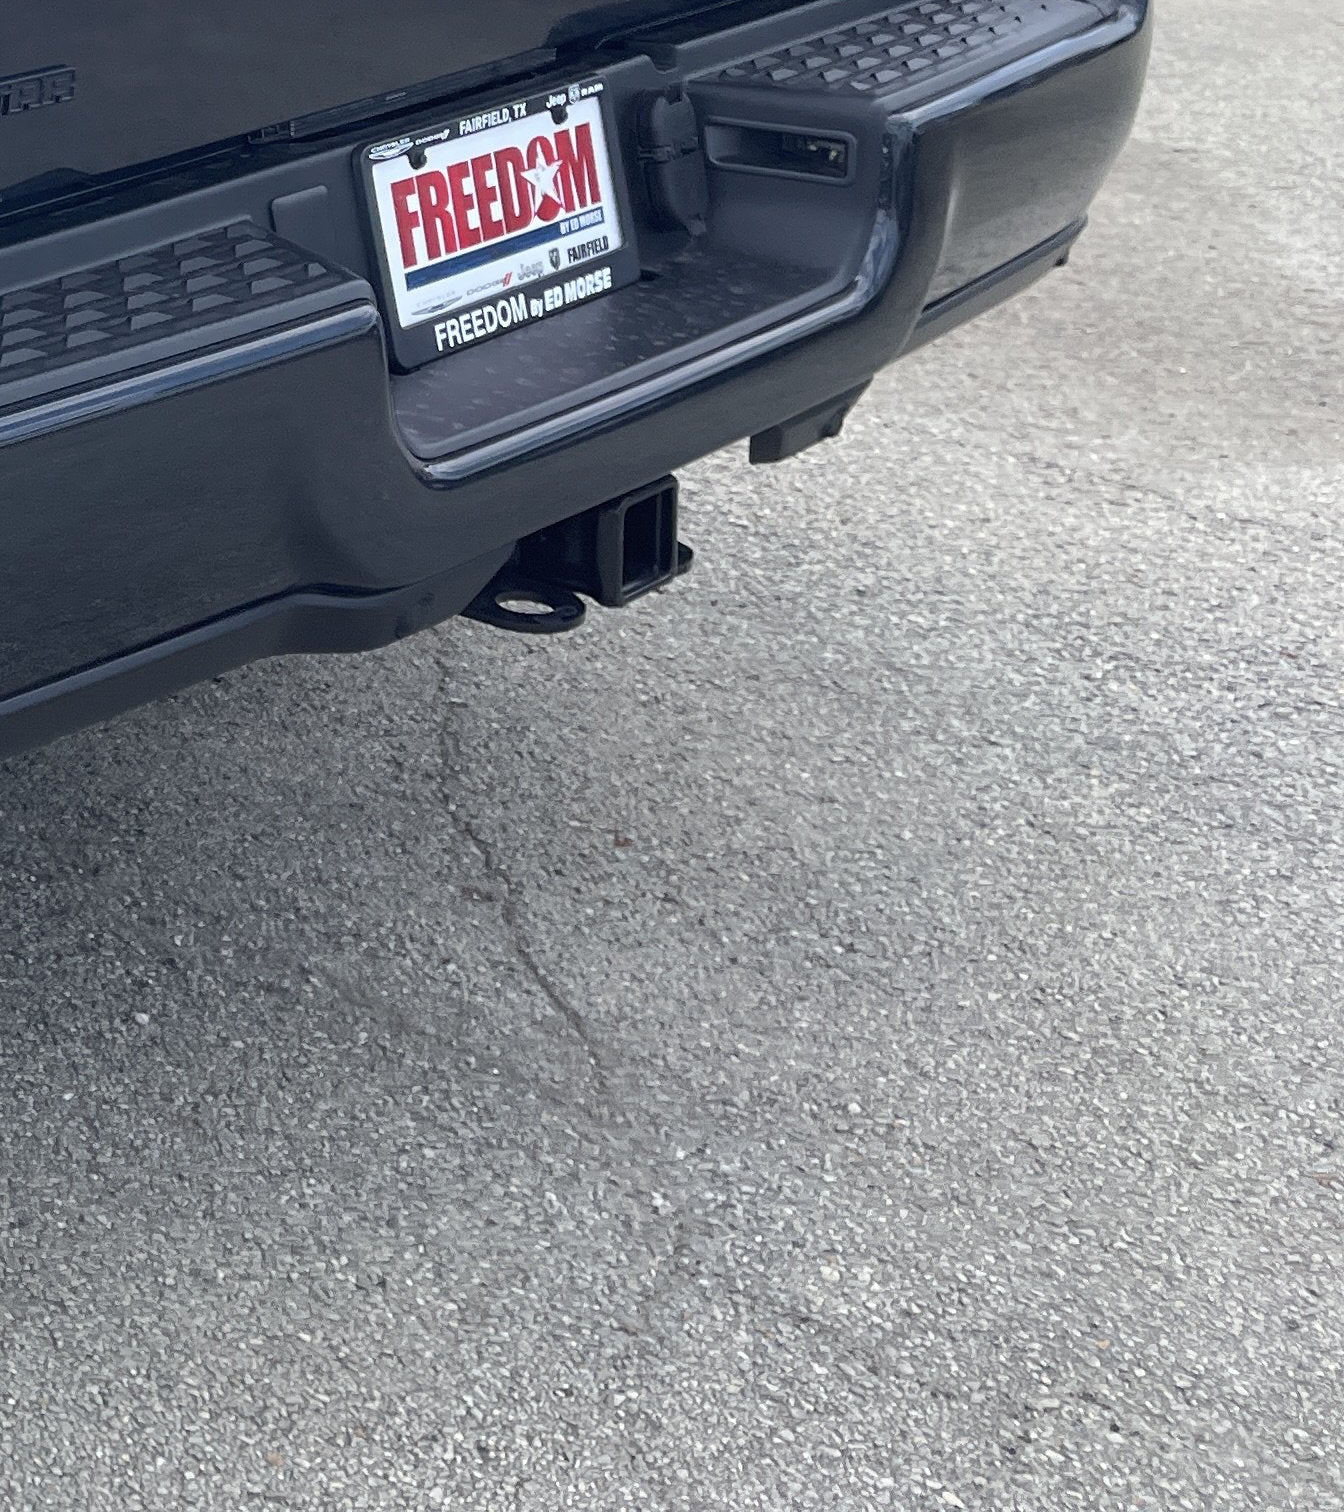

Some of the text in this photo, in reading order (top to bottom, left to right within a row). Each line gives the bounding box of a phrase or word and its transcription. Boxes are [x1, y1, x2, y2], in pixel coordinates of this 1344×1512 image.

[513, 102, 527, 119] TX
[390, 122, 601, 269] FREEDOM
[567, 236, 609, 264] FAIRFIELD
[434, 293, 529, 351] FREEDOM
[544, 287, 564, 312] ED
[564, 266, 612, 305] MORSE
